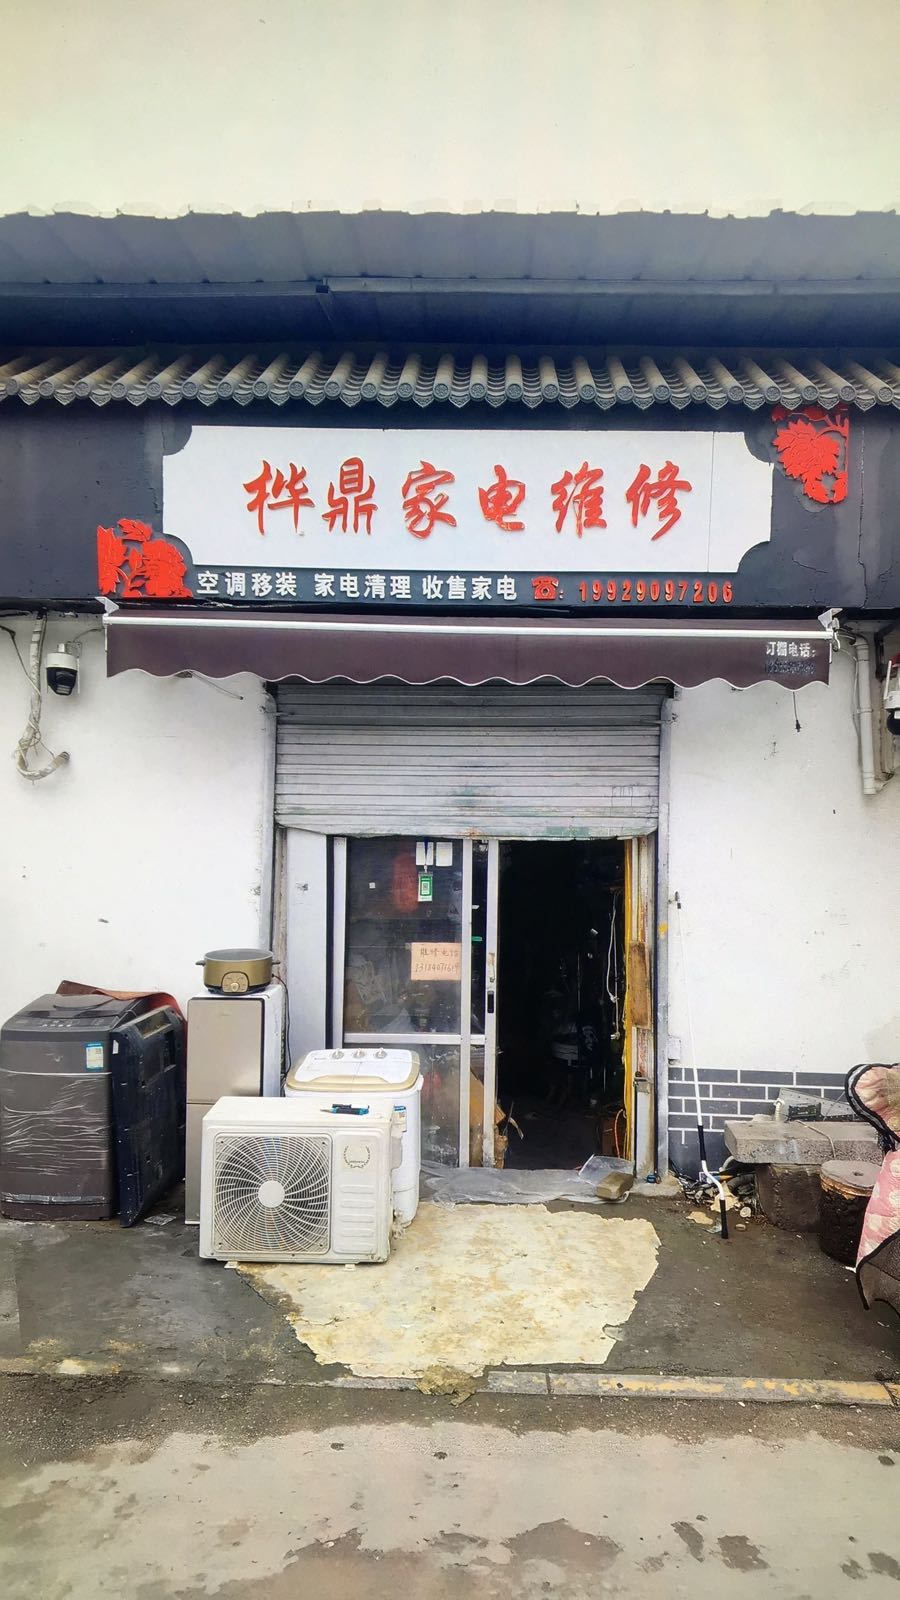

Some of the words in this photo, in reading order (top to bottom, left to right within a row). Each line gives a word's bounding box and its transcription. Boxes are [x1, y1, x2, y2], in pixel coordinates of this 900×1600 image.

[243, 457, 692, 540] 桦鼎家电维修
[196, 571, 297, 597] 空调移装
[314, 572, 412, 599] 家电清理
[422, 574, 518, 601] 收售家电
[579, 580, 733, 603] 19929097206
